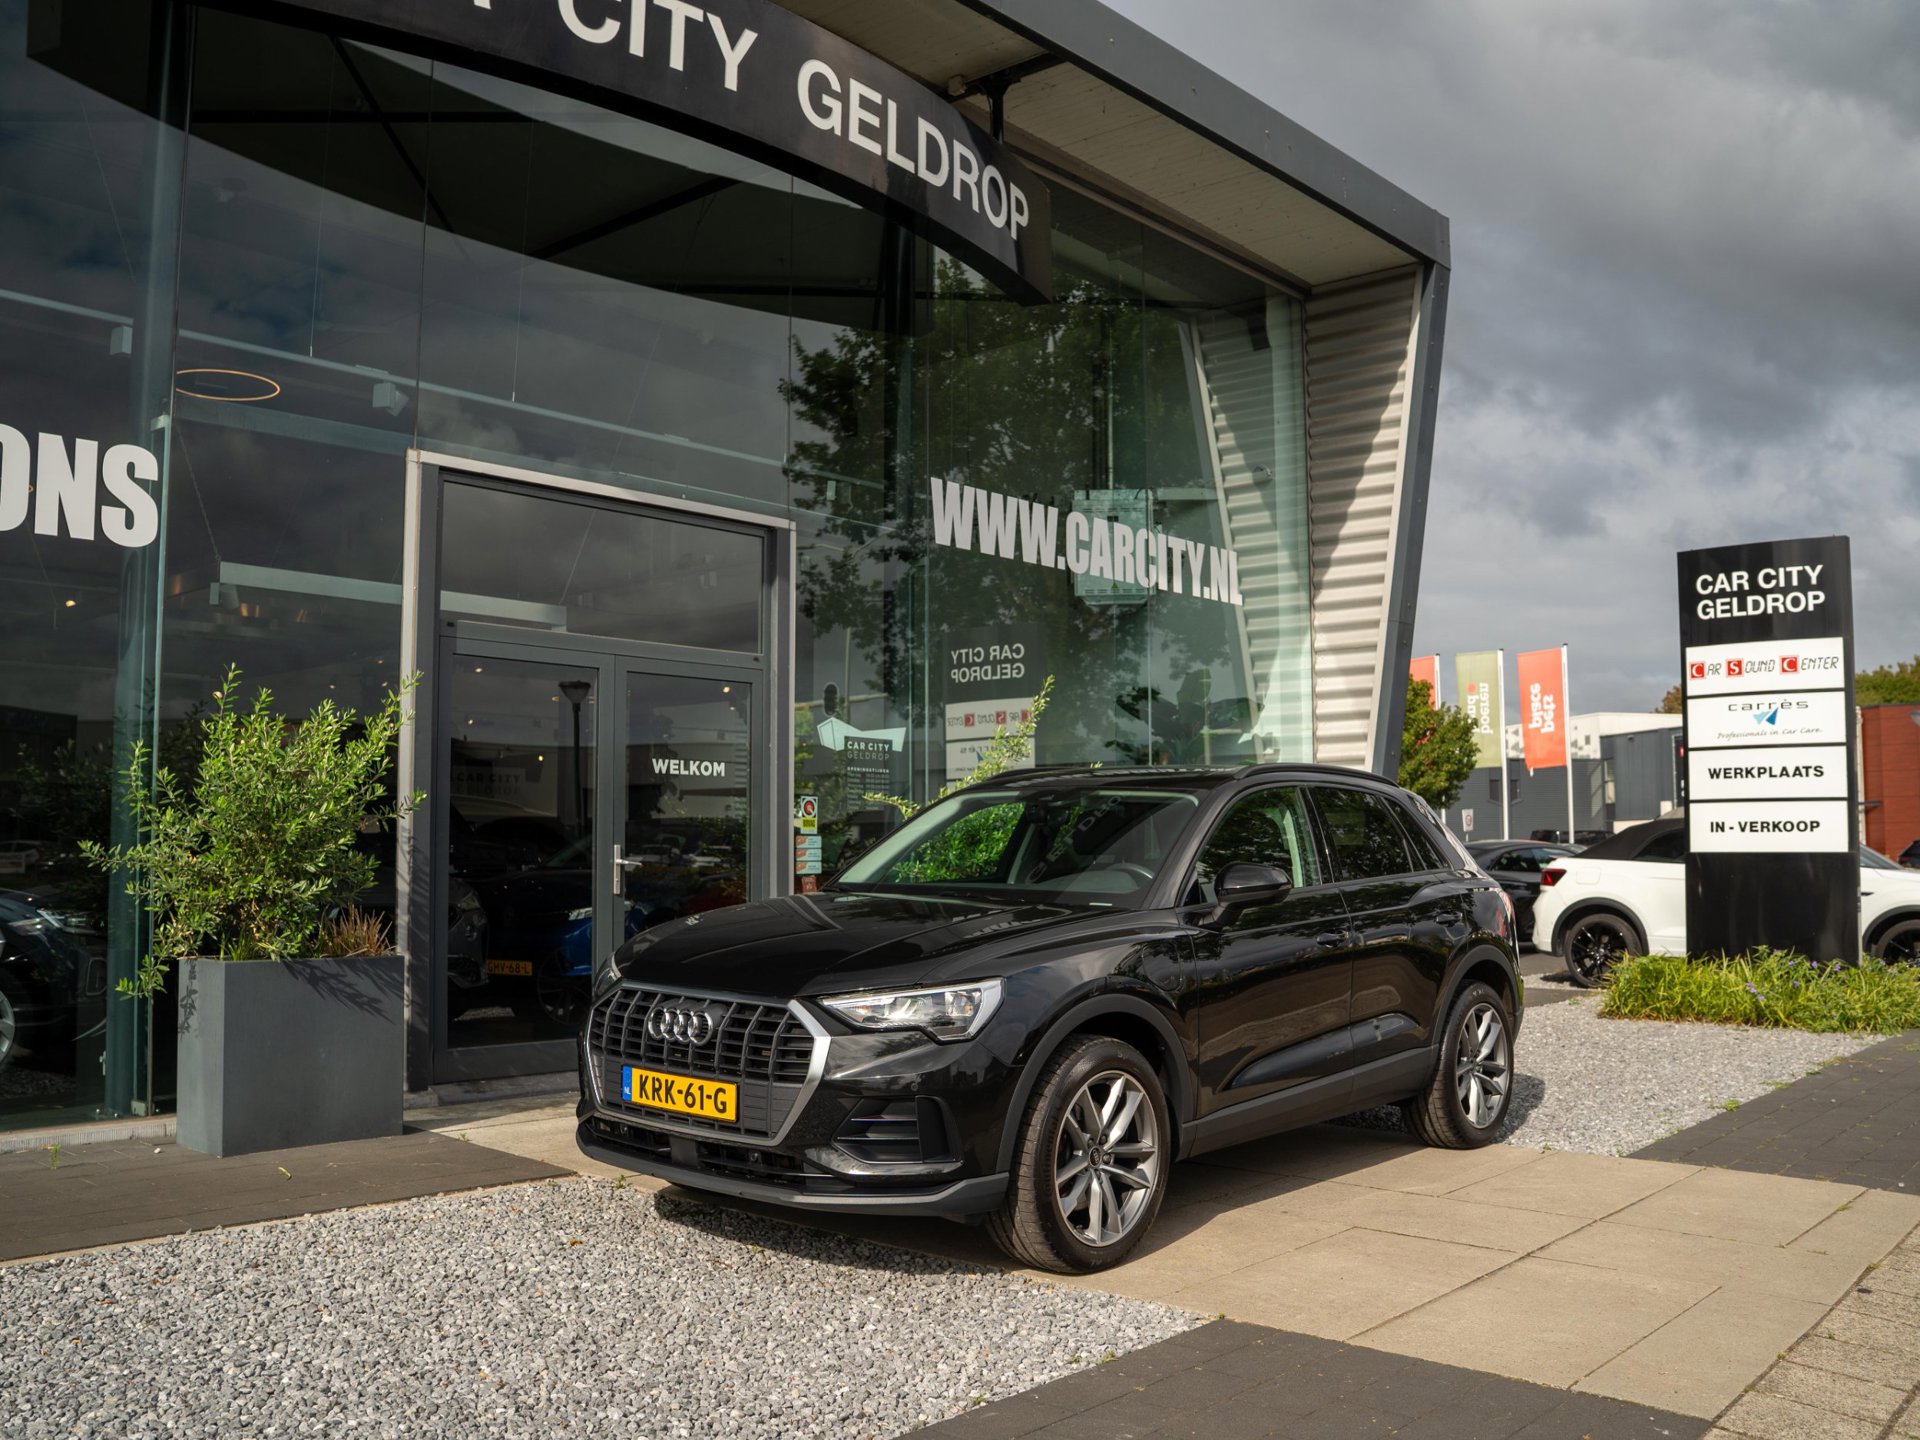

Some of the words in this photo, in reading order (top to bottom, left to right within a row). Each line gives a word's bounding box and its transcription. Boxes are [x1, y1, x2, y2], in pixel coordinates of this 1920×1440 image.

[557, 0, 758, 92] CITY
[797, 59, 1030, 240] GELDROP
[930, 477, 1243, 606] WWW.CARCITY.NL
[1696, 571, 1750, 595] CAR
[1757, 564, 1824, 589] CITY
[1697, 590, 1825, 620] GELDROP
[1690, 661, 1721, 679] CAR
[1726, 659, 1775, 678] SOUND
[1780, 655, 1839, 675] CENTER
[847, 741, 866, 750] CAR
[868, 743, 890, 752] CITY
[847, 751, 890, 761] GELDROP
[652, 758, 725, 776] WELKOM
[1708, 765, 1824, 779] WERKPLAATS
[1710, 821, 1726, 833] IN
[1738, 821, 1820, 833] VERKOOP
[624, 1086, 632, 1095] NL
[639, 1074, 727, 1114] KRK-61-G
